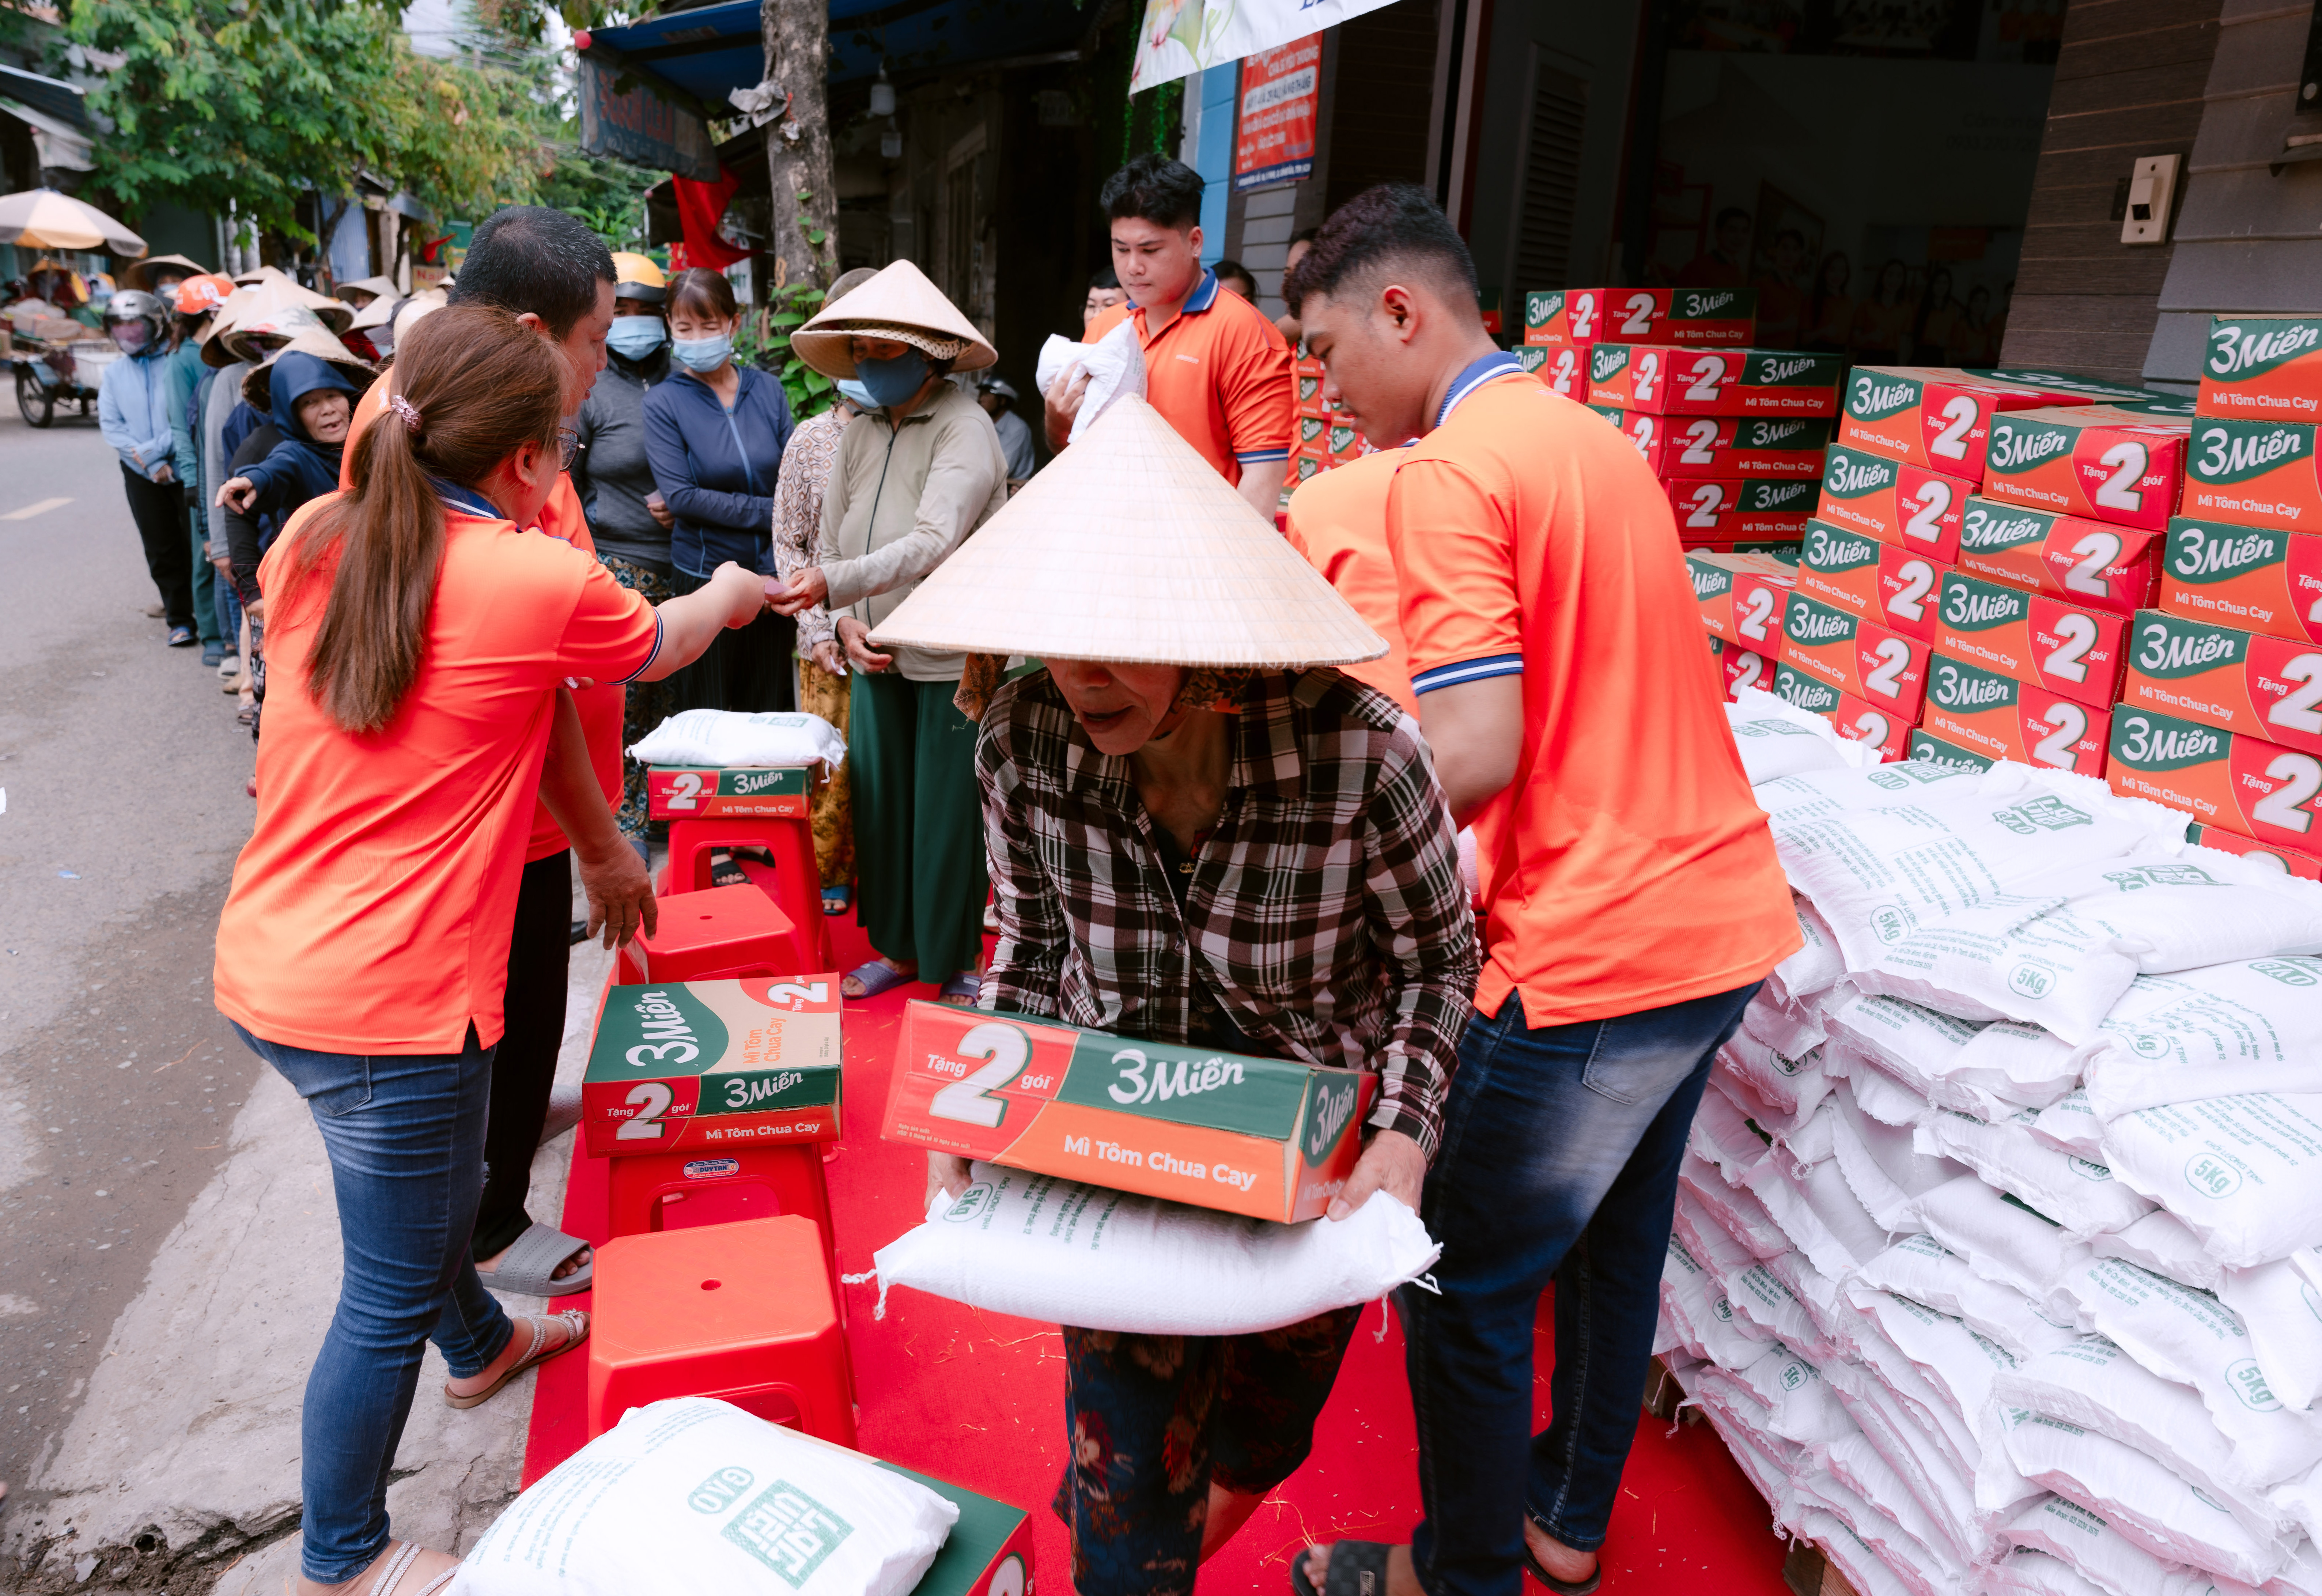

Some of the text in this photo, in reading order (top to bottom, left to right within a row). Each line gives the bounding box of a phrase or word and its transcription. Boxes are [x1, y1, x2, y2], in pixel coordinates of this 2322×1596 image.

[1572, 293, 1595, 337] 2
[1620, 292, 1656, 334] 2
[1674, 330, 1744, 340] Mì Tôm Chua Cay
[1636, 353, 1659, 401] 2
[1684, 355, 1725, 401] 2
[1759, 398, 1779, 406] Tôm
[1807, 399, 1824, 408] Cay
[2213, 393, 2318, 412] Mì Tôm Chua Cay
[1680, 419, 1720, 464] 2
[1850, 428, 1910, 453] Mì Tôm Chua Cay
[1928, 396, 1985, 460] Tặng 2 gói
[1993, 482, 2069, 506] Mì Tôm Chua Cay
[2083, 441, 2163, 512] Tặng 2 gói
[1686, 484, 1724, 527] 2
[1902, 480, 1958, 543] Tặng 2 gói
[2198, 495, 2301, 519] Mì Tôm Chua Cay
[2050, 552, 2074, 567] Tặng
[2065, 532, 2122, 598] 2
[1887, 560, 1935, 622] 2
[1739, 587, 1775, 642] 2
[1866, 638, 1910, 699] 2
[2037, 613, 2107, 684] Tặng 2 gói
[2258, 653, 2322, 735] Tặng 2
[2033, 702, 2087, 771] 2
[668, 773, 703, 809] 2
[1878, 911, 1901, 939] 5Kg
[767, 982, 828, 1003] 2
[2017, 968, 2047, 994] 5Kg
[793, 999, 804, 1011] Tặng
[743, 1029, 762, 1064] Mì Tôm
[764, 1018, 787, 1062] Chua Cay
[724, 1072, 803, 1108] 3Miền
[927, 1023, 1051, 1128] Tặng 2 gói
[1108, 1048, 1245, 1105] 3Miền
[607, 1082, 689, 1141] Tặng 2 gói
[706, 1123, 820, 1139] Mì Tôm Chua Cay
[1064, 1135, 1257, 1191] Mì Tôm Chua Cay
[2194, 1159, 2231, 1194] 5Kg
[949, 1189, 984, 1216] 5Kg
[2238, 1366, 2274, 1405] 5Kg
